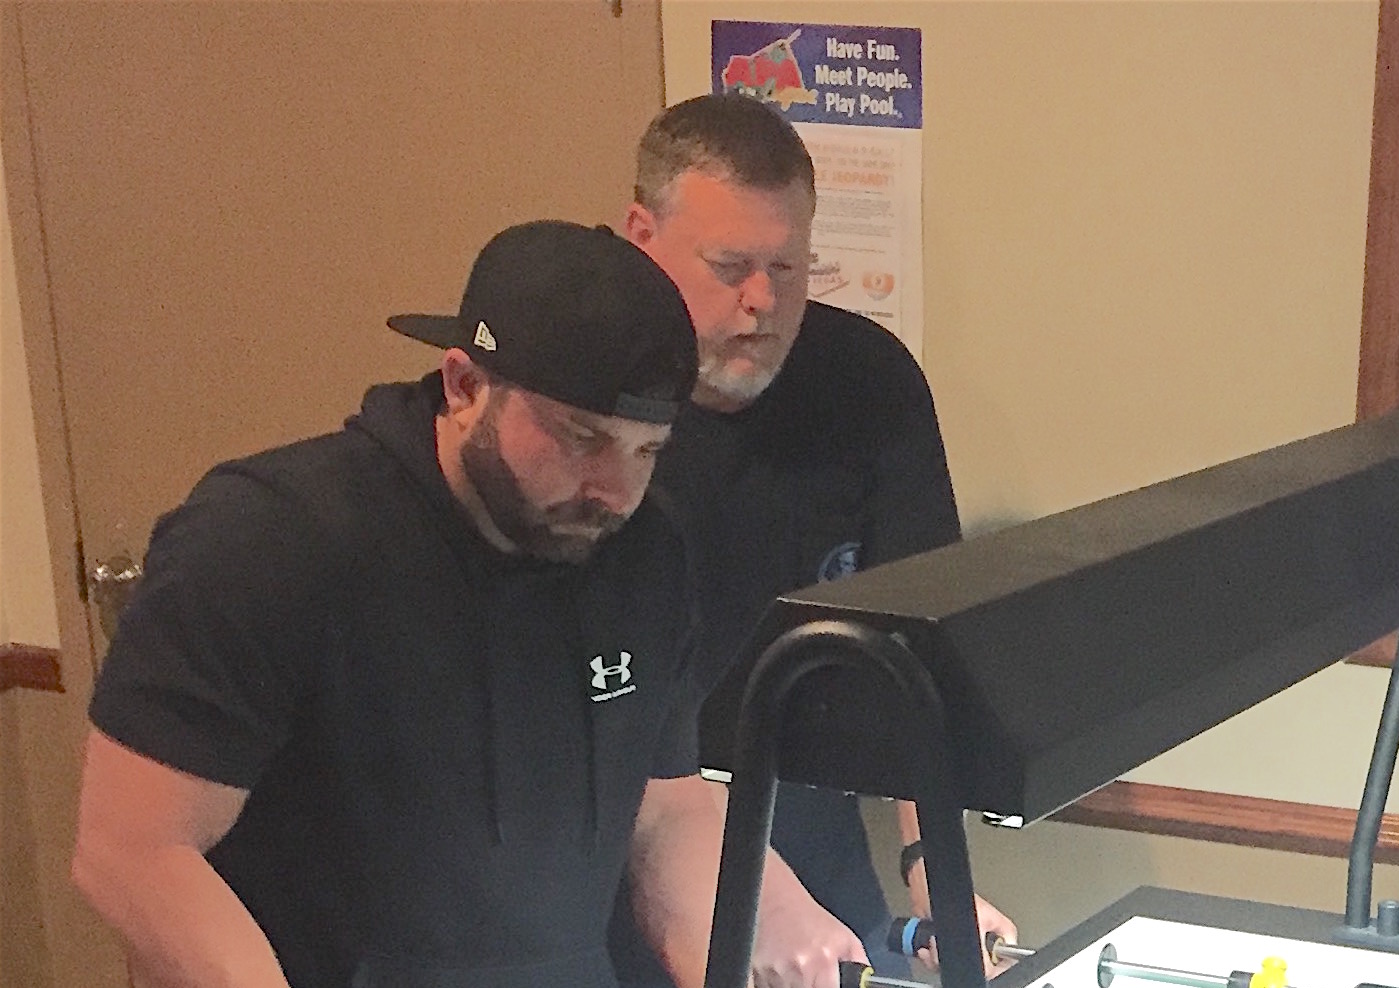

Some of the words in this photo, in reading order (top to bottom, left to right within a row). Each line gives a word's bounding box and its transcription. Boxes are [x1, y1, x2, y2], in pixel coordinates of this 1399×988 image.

[826, 37, 862, 59] Have
[867, 39, 900, 61] Fun.
[815, 64, 853, 86] Meet
[857, 66, 912, 92] People.
[825, 92, 856, 117] Play
[860, 93, 898, 115] Pool.
